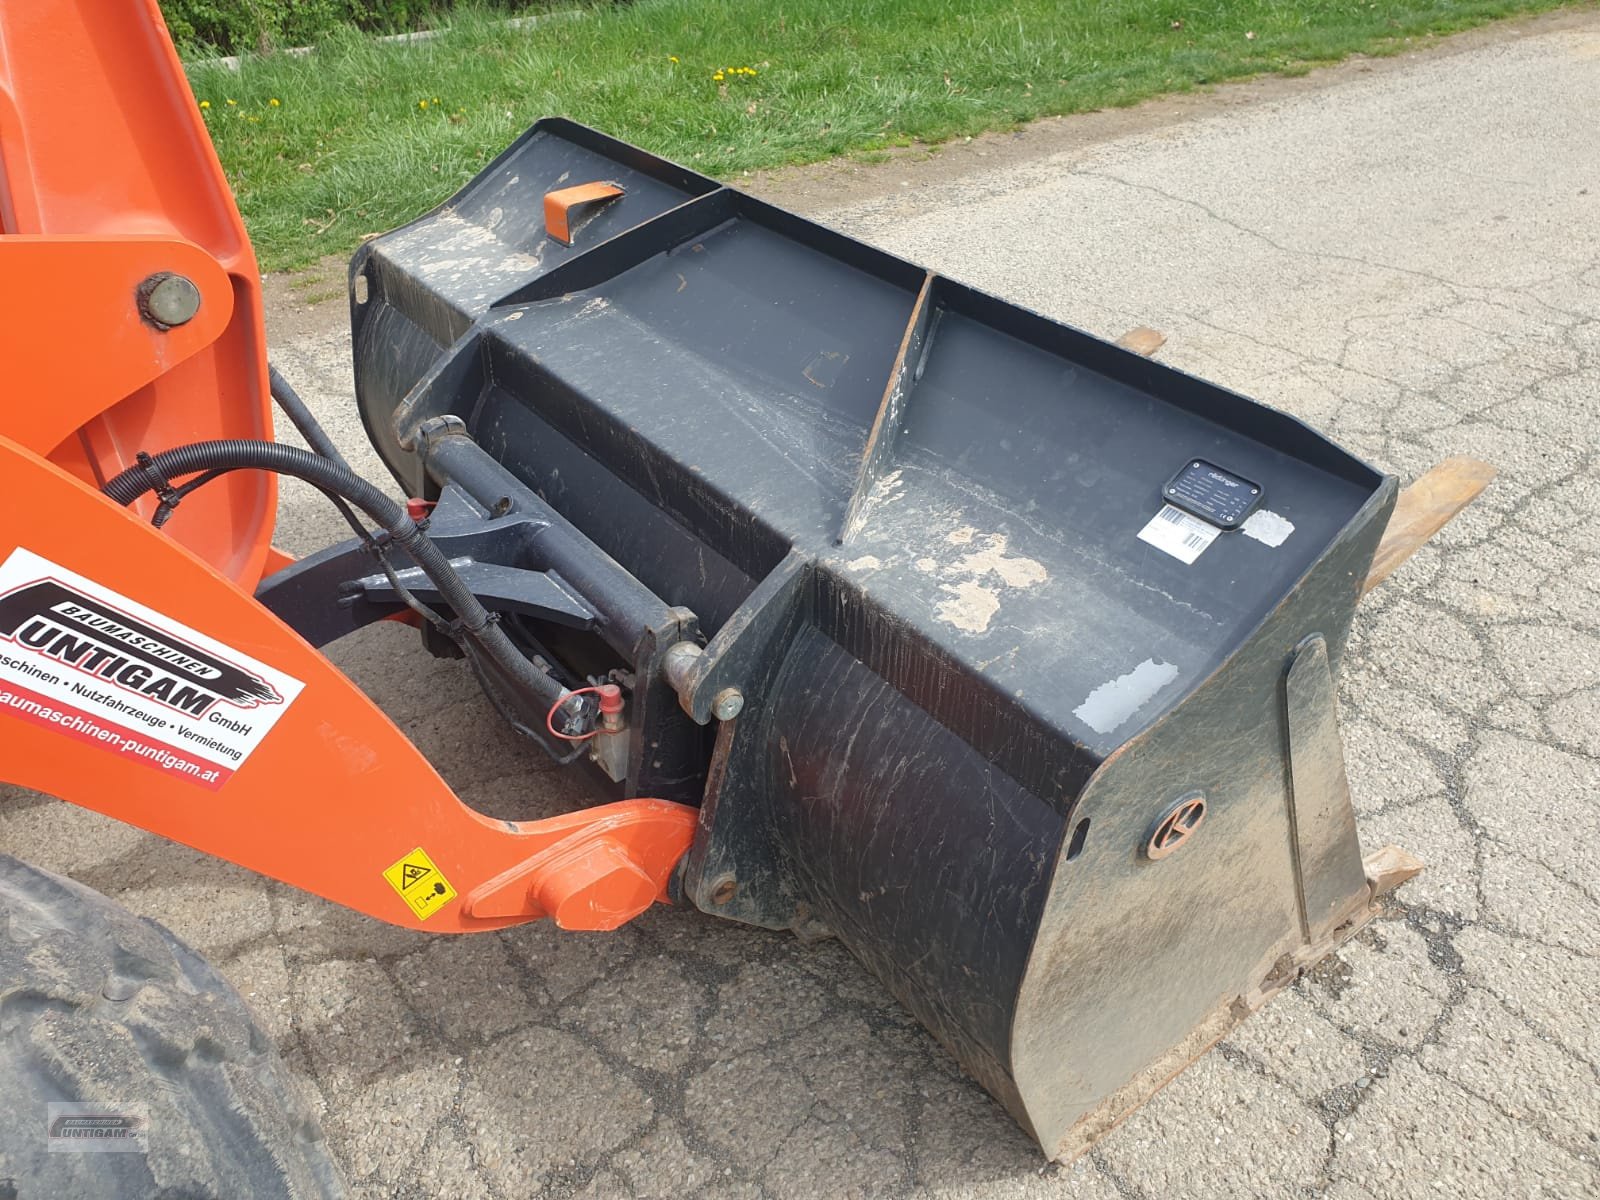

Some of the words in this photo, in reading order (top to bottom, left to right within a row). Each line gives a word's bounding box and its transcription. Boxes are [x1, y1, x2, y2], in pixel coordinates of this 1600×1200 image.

[61, 606, 212, 676] BAUMASCHINEN
[0, 653, 60, 685] schinen
[71, 682, 167, 729] Nutzfahrzeuge
[177, 724, 242, 761] Vermietung
[0, 690, 220, 783] aumaschinen-puntigam.at
[208, 711, 252, 737] GmbH
